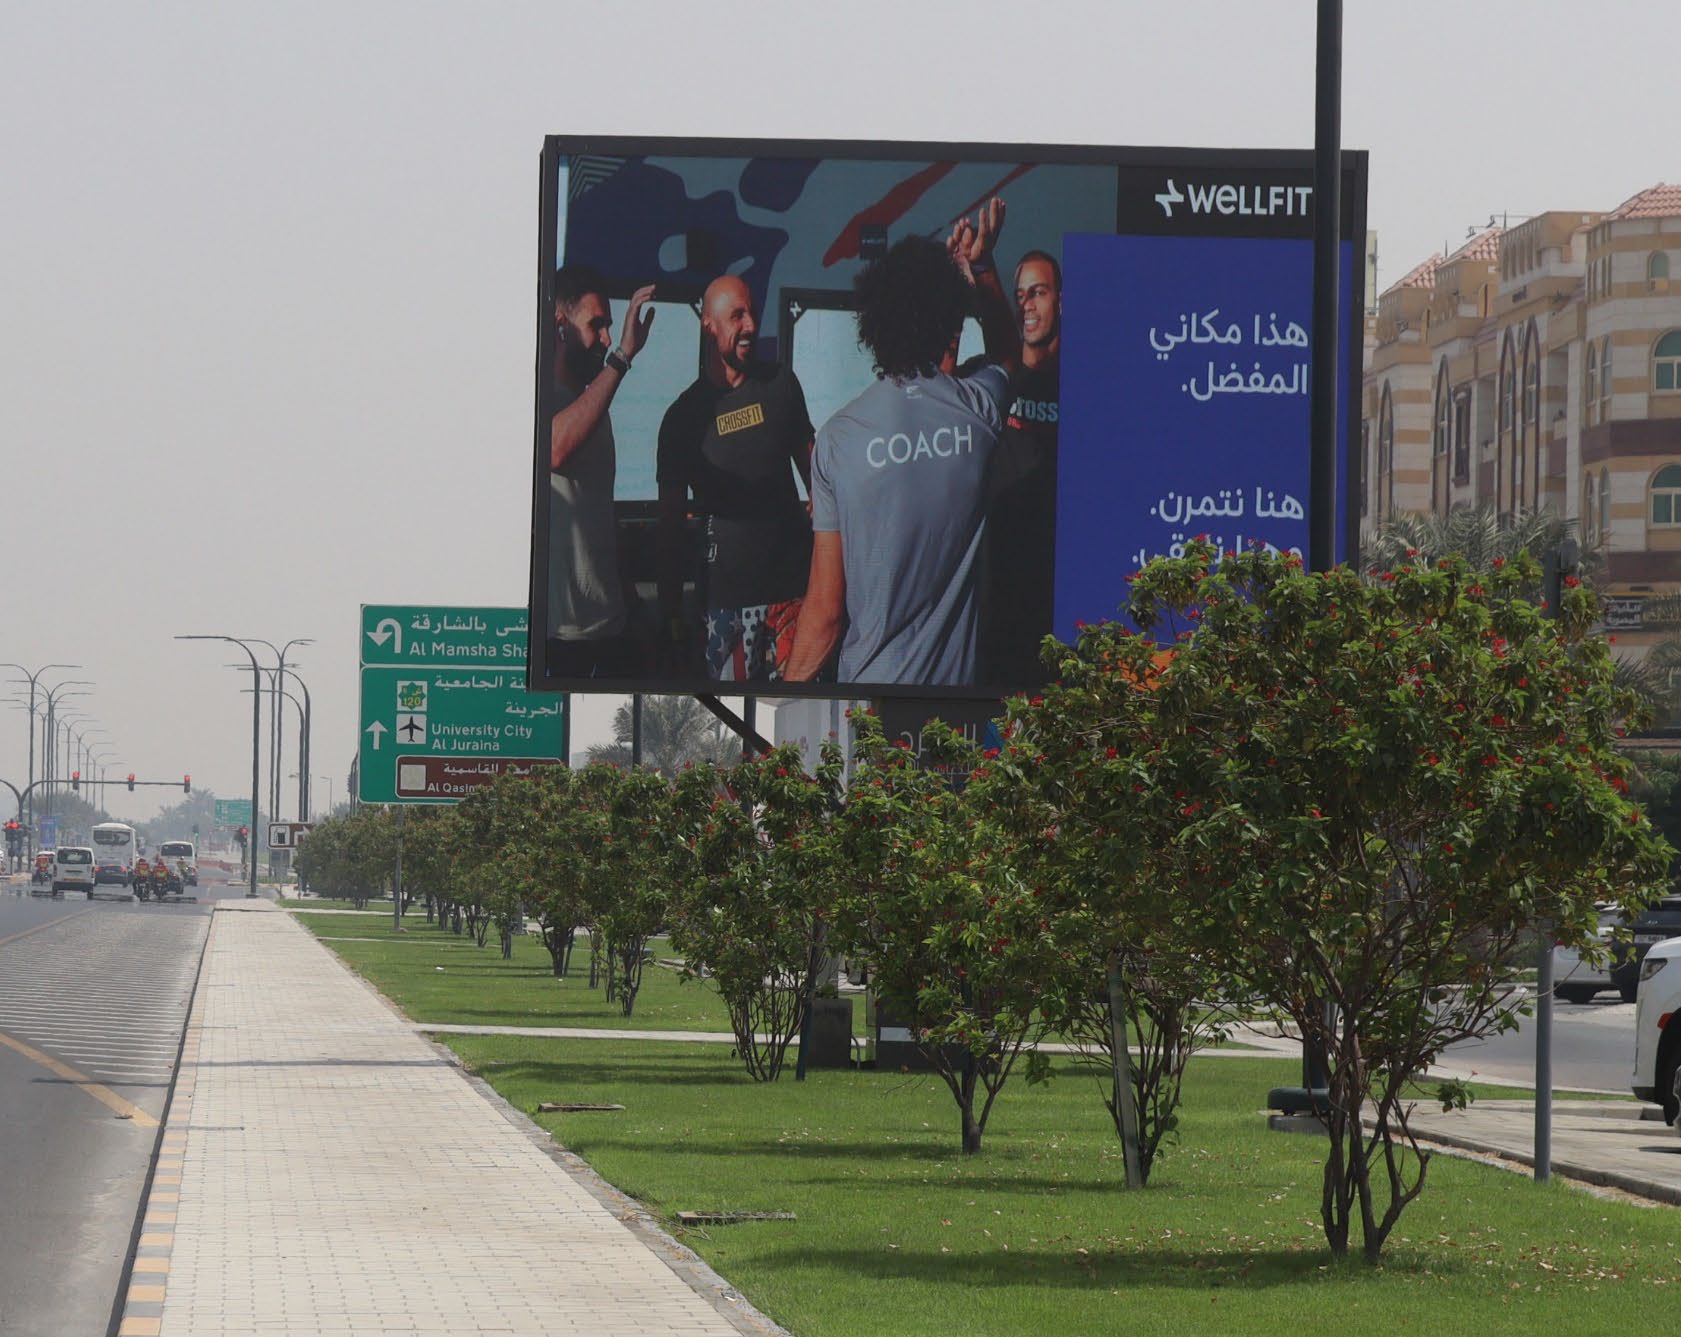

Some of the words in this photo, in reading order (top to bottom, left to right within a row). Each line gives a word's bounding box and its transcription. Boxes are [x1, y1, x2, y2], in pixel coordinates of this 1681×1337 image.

[1149, 308, 1242, 360] مكاني
[1254, 312, 1308, 347] هذا
[1181, 361, 1308, 401] المفضل.
[720, 406, 763, 433] CROSSFIT
[866, 425, 972, 469] COACH
[1150, 488, 1243, 525] نتمرن.
[1255, 486, 1304, 520] هنا
[411, 613, 487, 636] بالشارقة
[409, 642, 426, 656] Al
[432, 642, 497, 657] Mamsha
[502, 643, 528, 658] Sha
[435, 675, 503, 691] الجامعية
[505, 701, 564, 718] الجرينة
[432, 723, 500, 738] University
[504, 724, 533, 739] City
[432, 738, 446, 750] Al
[451, 738, 500, 751] Juraina
[443, 763, 499, 776] القاسمية
[427, 782, 440, 793] Al
